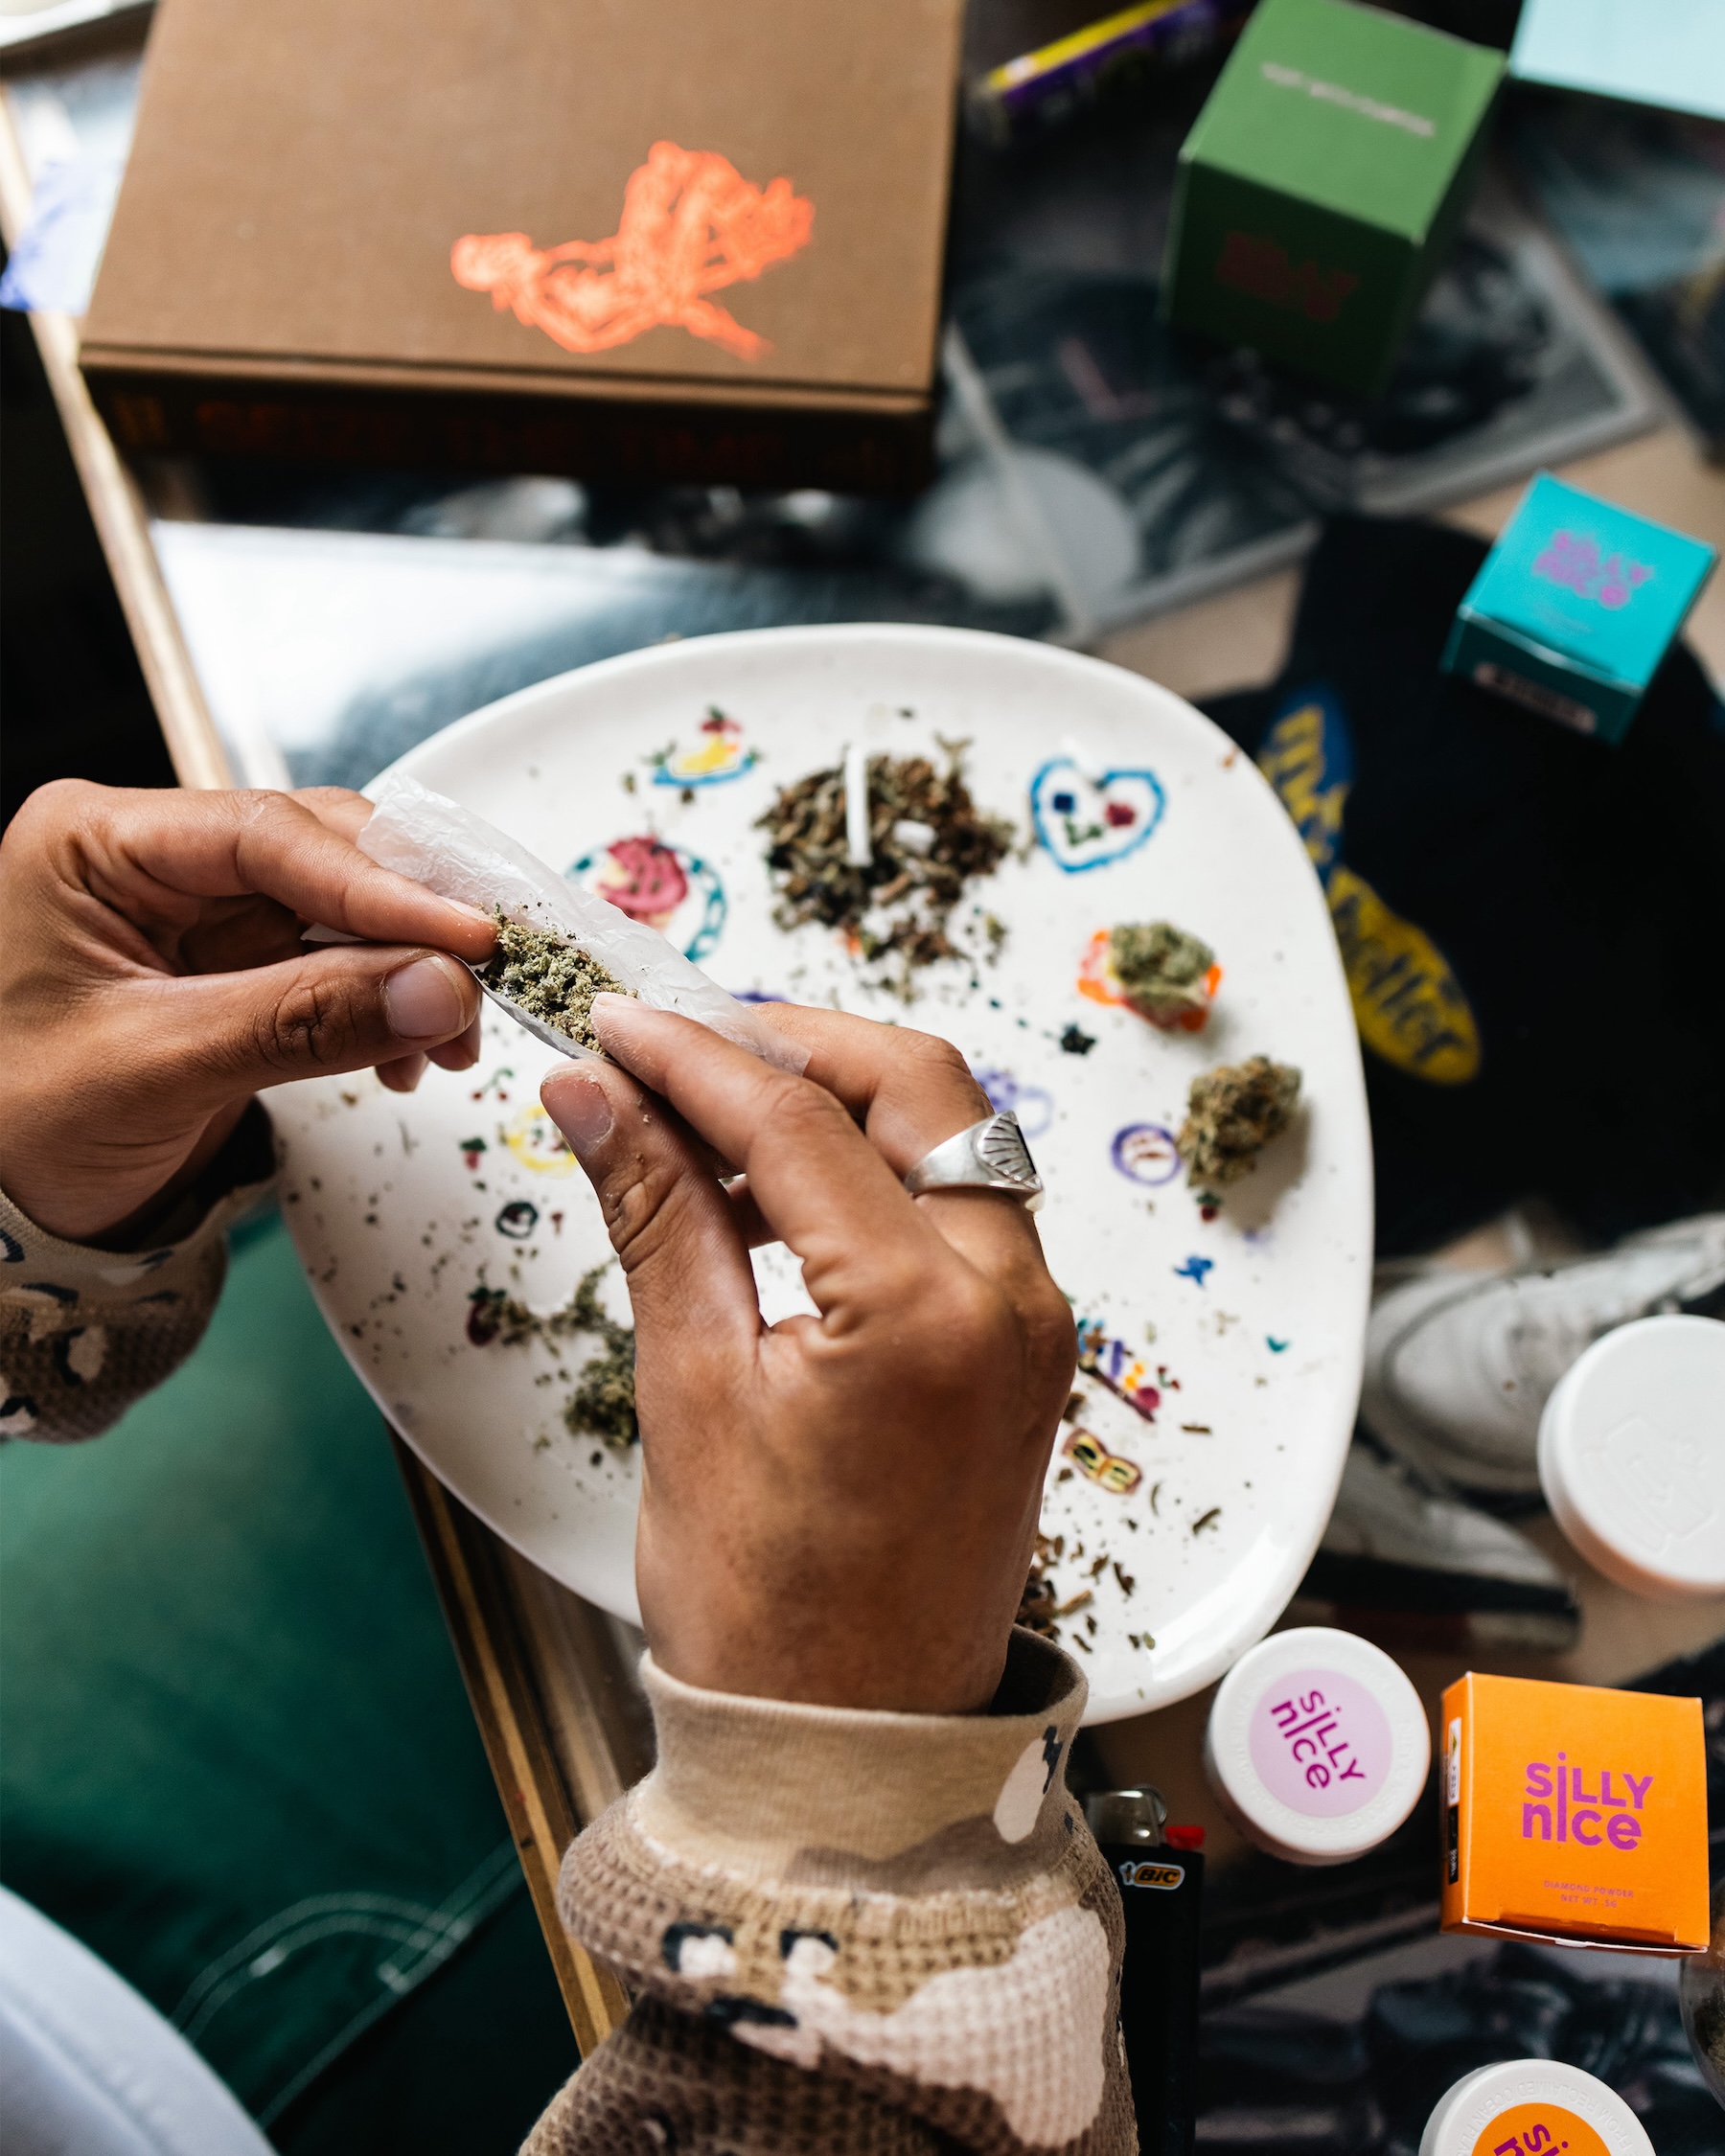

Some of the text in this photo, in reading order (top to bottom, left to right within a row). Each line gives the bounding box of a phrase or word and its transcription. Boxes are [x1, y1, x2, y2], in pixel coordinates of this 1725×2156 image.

[1138, 1868, 1178, 1884] BIC
[1543, 1880, 1634, 1898] DIAMOND POWDER
[1560, 1894, 1579, 1904] NET
[1517, 2080, 1598, 2113] RECLAIMED
[1472, 2088, 1514, 2126] OCEAN
